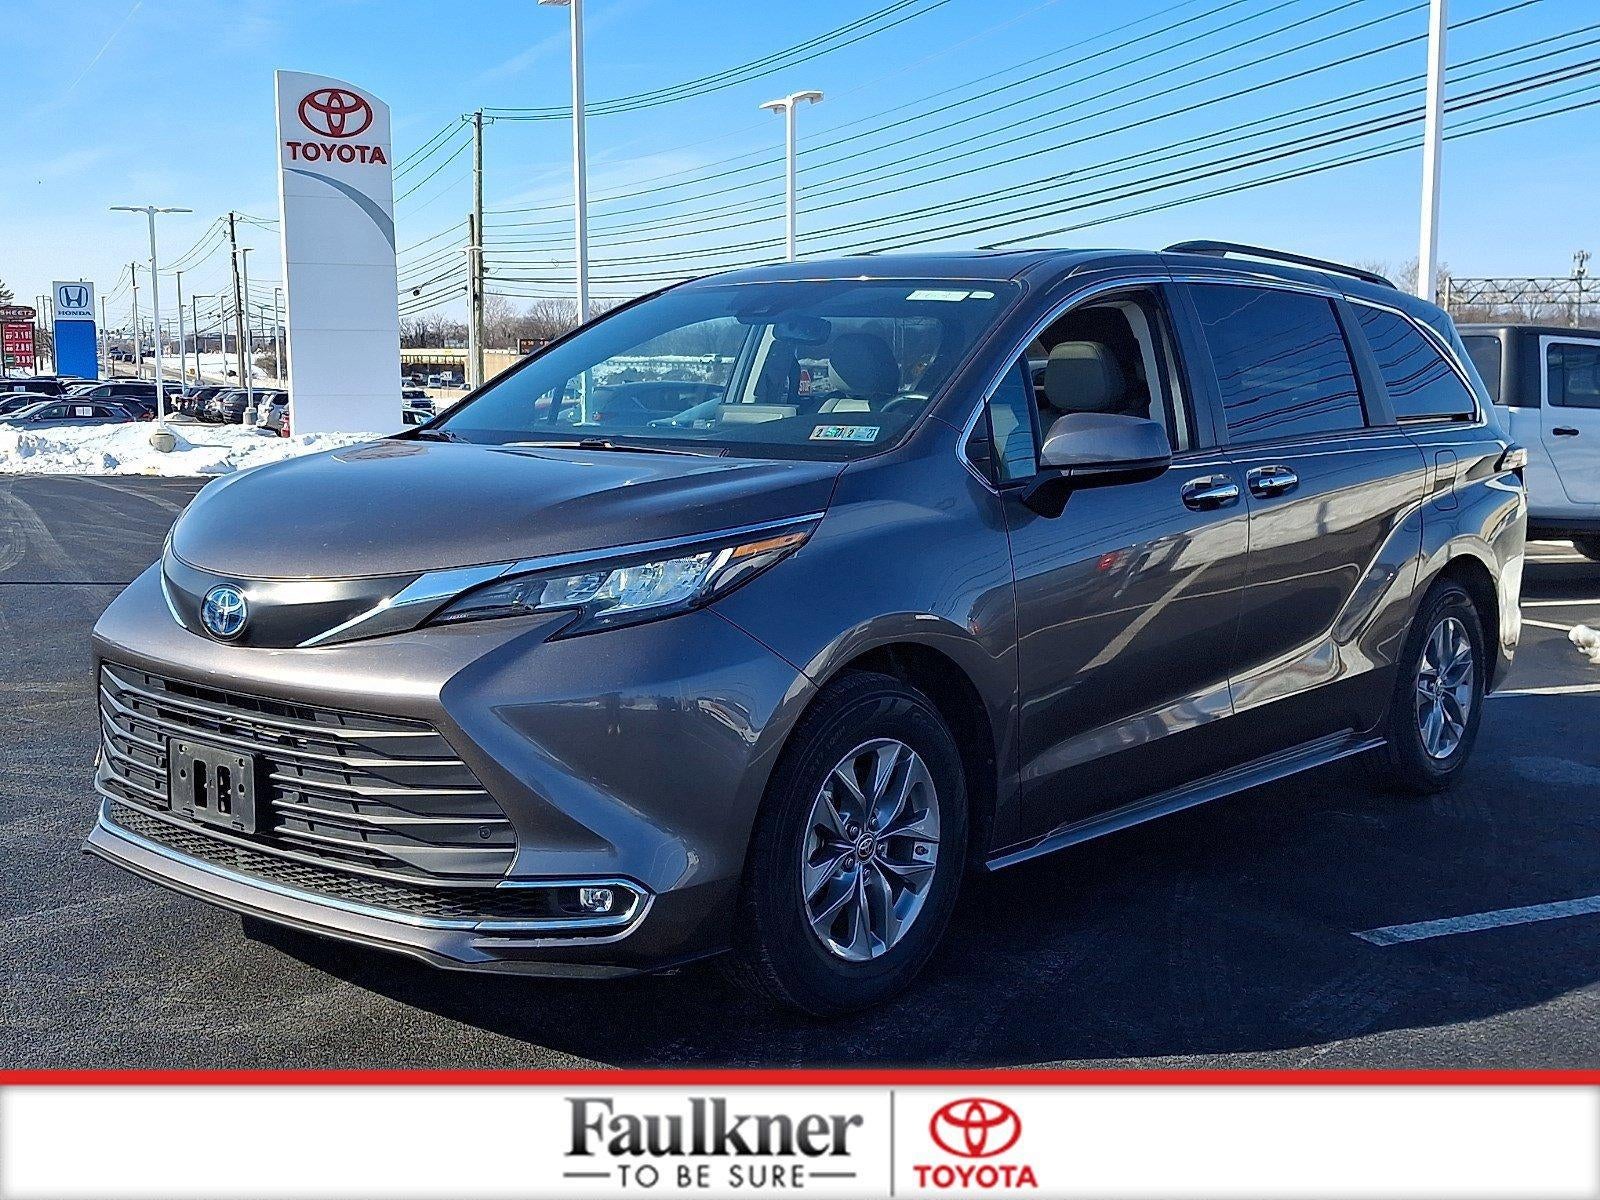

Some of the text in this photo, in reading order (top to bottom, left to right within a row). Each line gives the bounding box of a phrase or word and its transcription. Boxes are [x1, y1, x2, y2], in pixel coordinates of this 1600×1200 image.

[286, 141, 388, 165] TOYOTA
[814, 428, 824, 438] 2
[847, 428, 877, 439] 2 27
